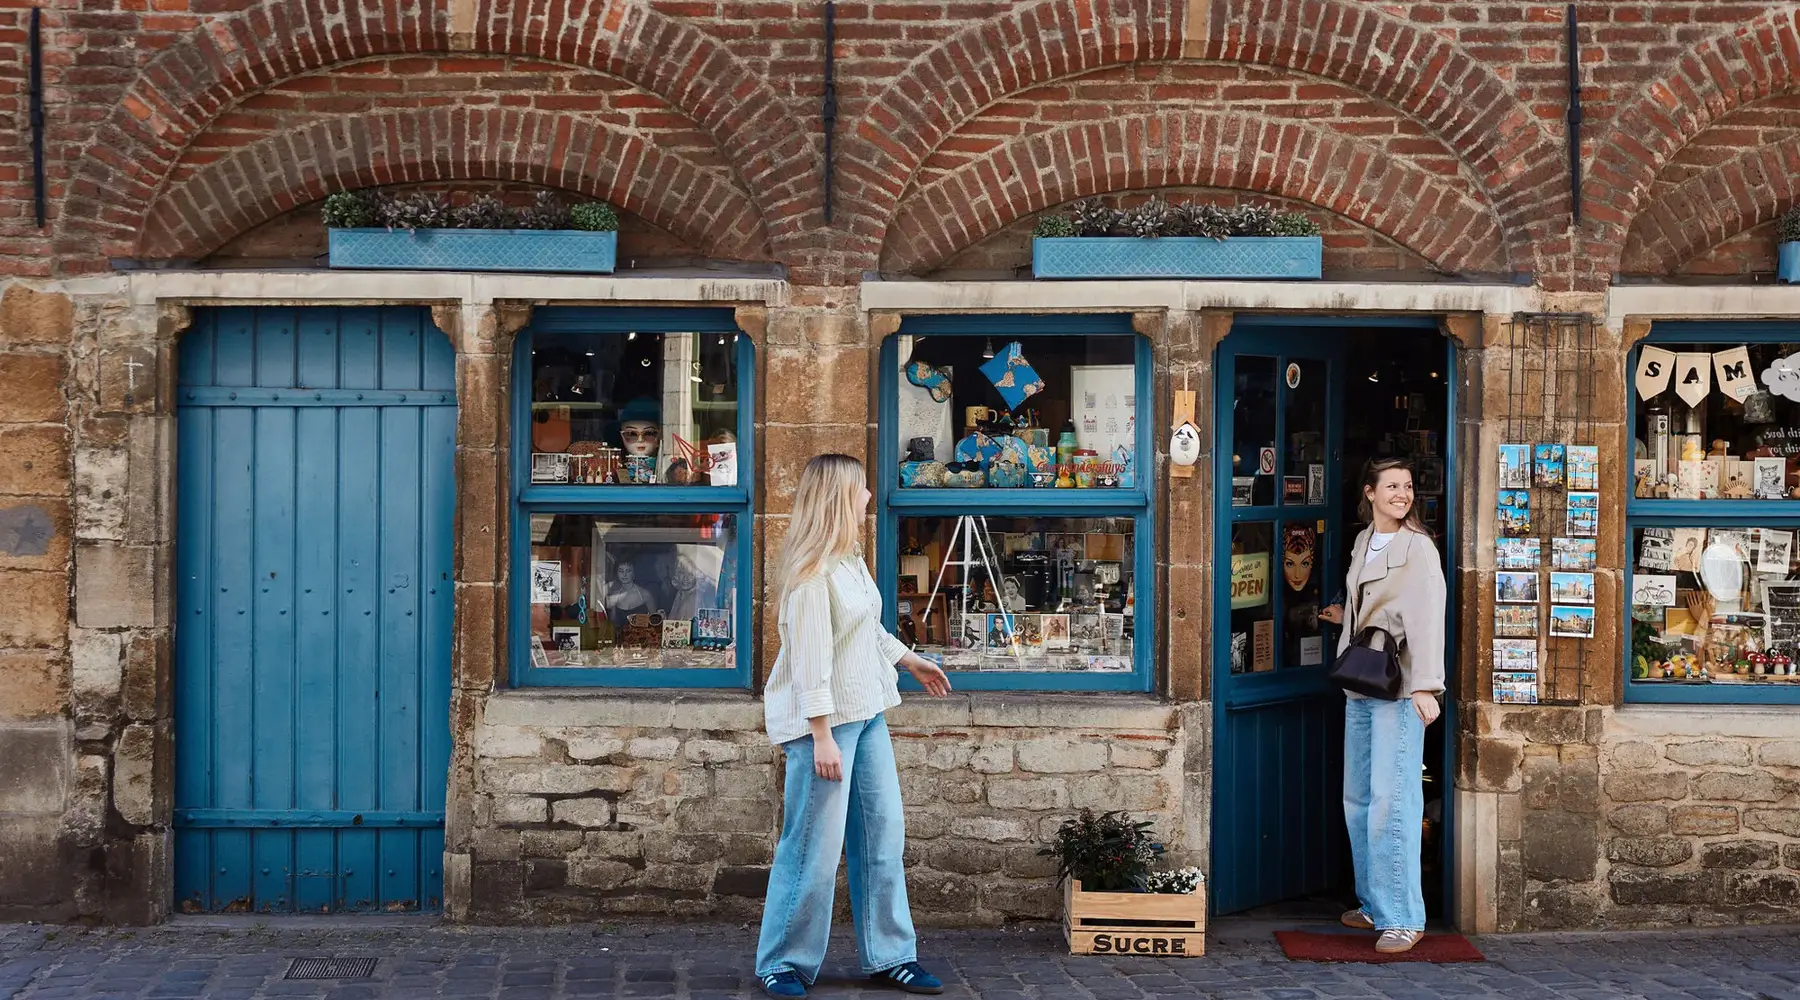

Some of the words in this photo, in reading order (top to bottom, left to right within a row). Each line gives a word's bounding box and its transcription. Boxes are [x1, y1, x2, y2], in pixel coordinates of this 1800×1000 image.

[1231, 559, 1254, 576] Come
[1254, 560, 1262, 568] in
[1231, 578, 1264, 598] OPEN
[1093, 934, 1186, 954] SUCRE
